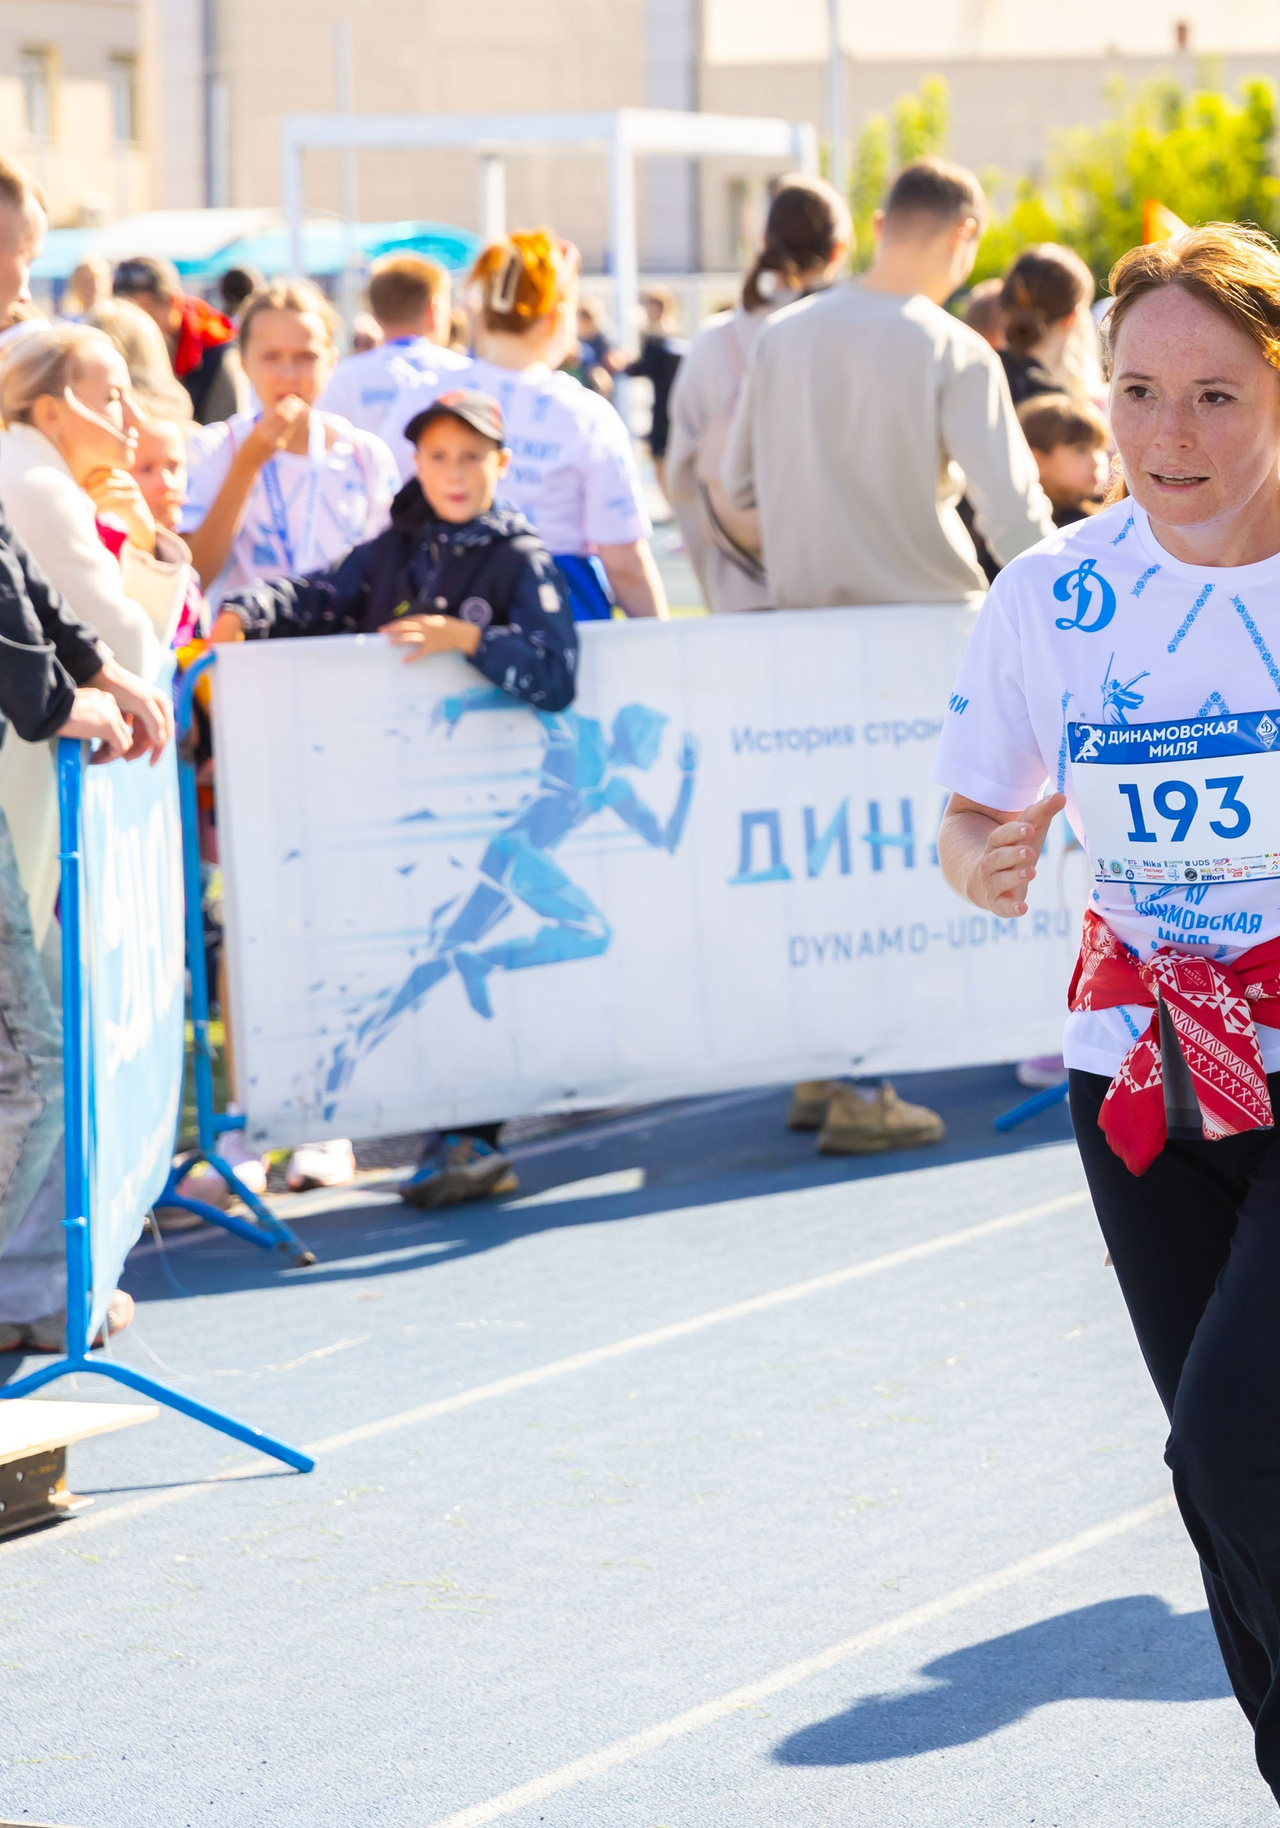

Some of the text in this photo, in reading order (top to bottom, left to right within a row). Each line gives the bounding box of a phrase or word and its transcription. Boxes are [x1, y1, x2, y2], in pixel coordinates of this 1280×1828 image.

[732, 717, 854, 755] История
[1107, 719, 1239, 745] ДИНАМОВСКАЯ
[1149, 740, 1198, 758] МИЛЯ
[1118, 775, 1252, 843] 193
[788, 906, 1073, 967] DYNAMO-UDM.RU
